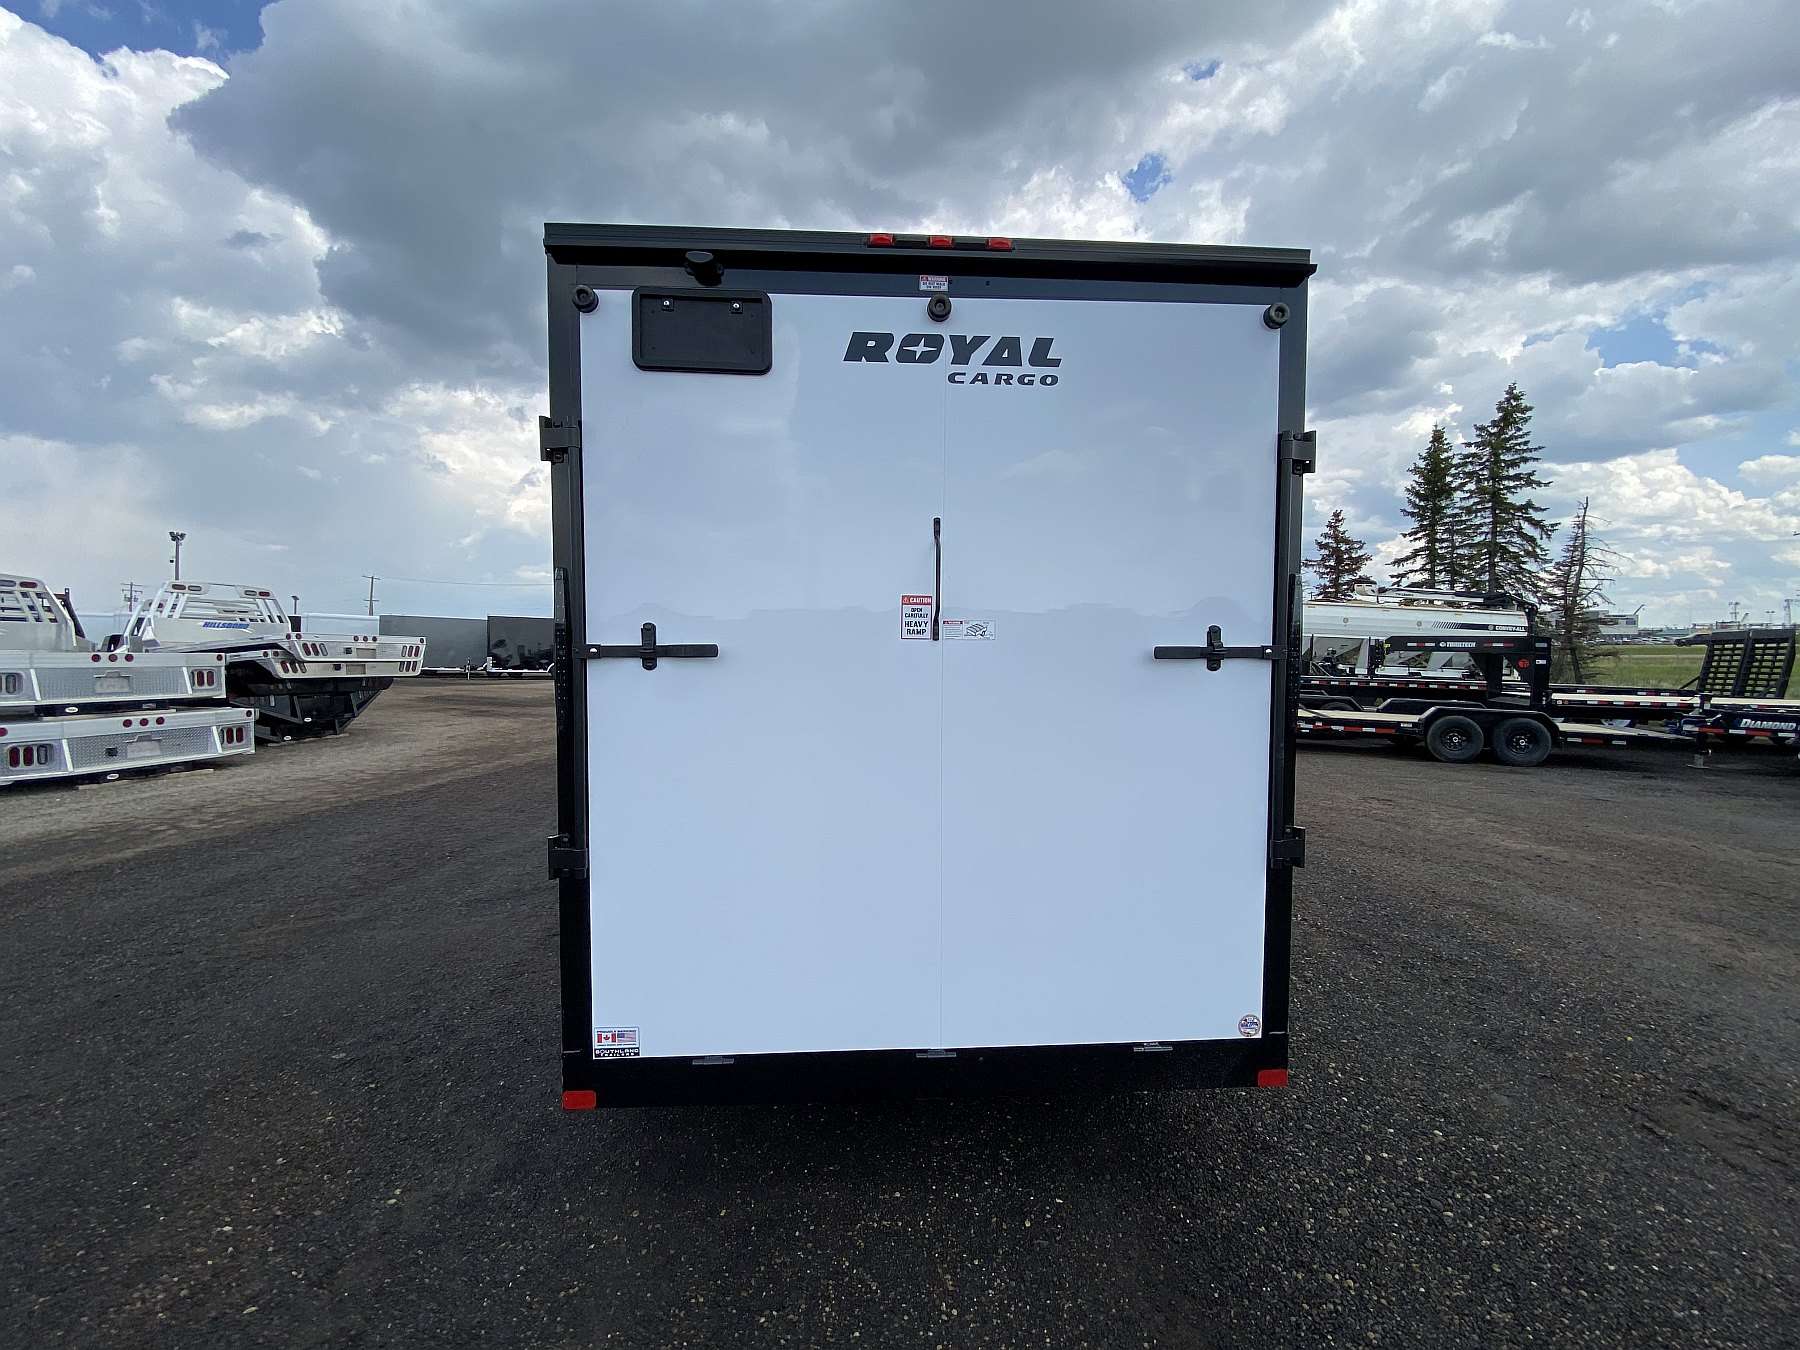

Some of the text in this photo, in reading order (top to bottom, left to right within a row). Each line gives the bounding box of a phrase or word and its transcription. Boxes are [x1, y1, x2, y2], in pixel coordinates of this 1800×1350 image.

[843, 332, 1062, 367] ROYAL
[948, 372, 1059, 386] CARGO
[904, 620, 928, 628] HEAVY
[906, 628, 927, 636] RAMP
[1740, 718, 1796, 731] DIAMOND
